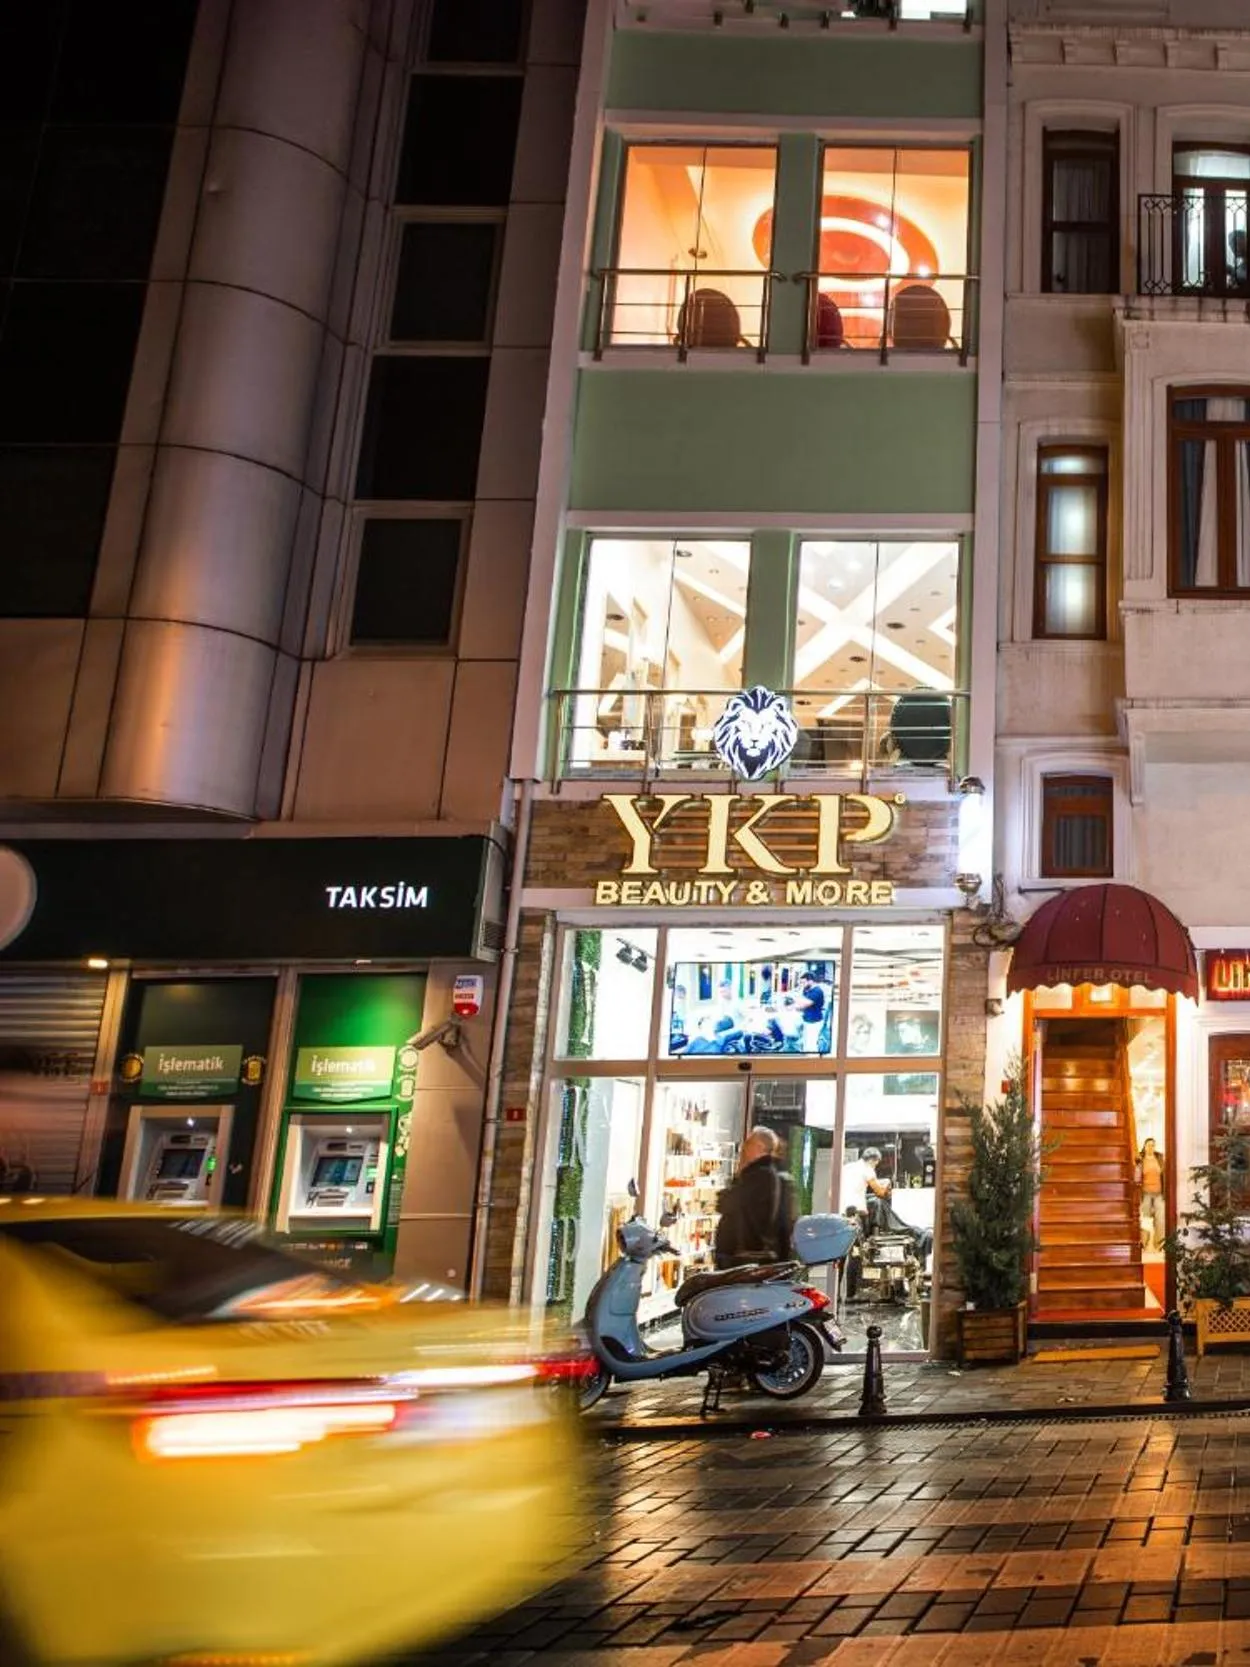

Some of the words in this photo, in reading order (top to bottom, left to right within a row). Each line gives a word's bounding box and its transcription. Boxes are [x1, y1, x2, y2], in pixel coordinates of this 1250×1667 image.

[602, 792, 894, 875] YKP
[325, 881, 428, 908] TAKSİM
[596, 880, 739, 906] BEAUTY
[746, 880, 769, 905] &
[786, 880, 893, 906] MORE
[1111, 969, 1152, 984] OTEL
